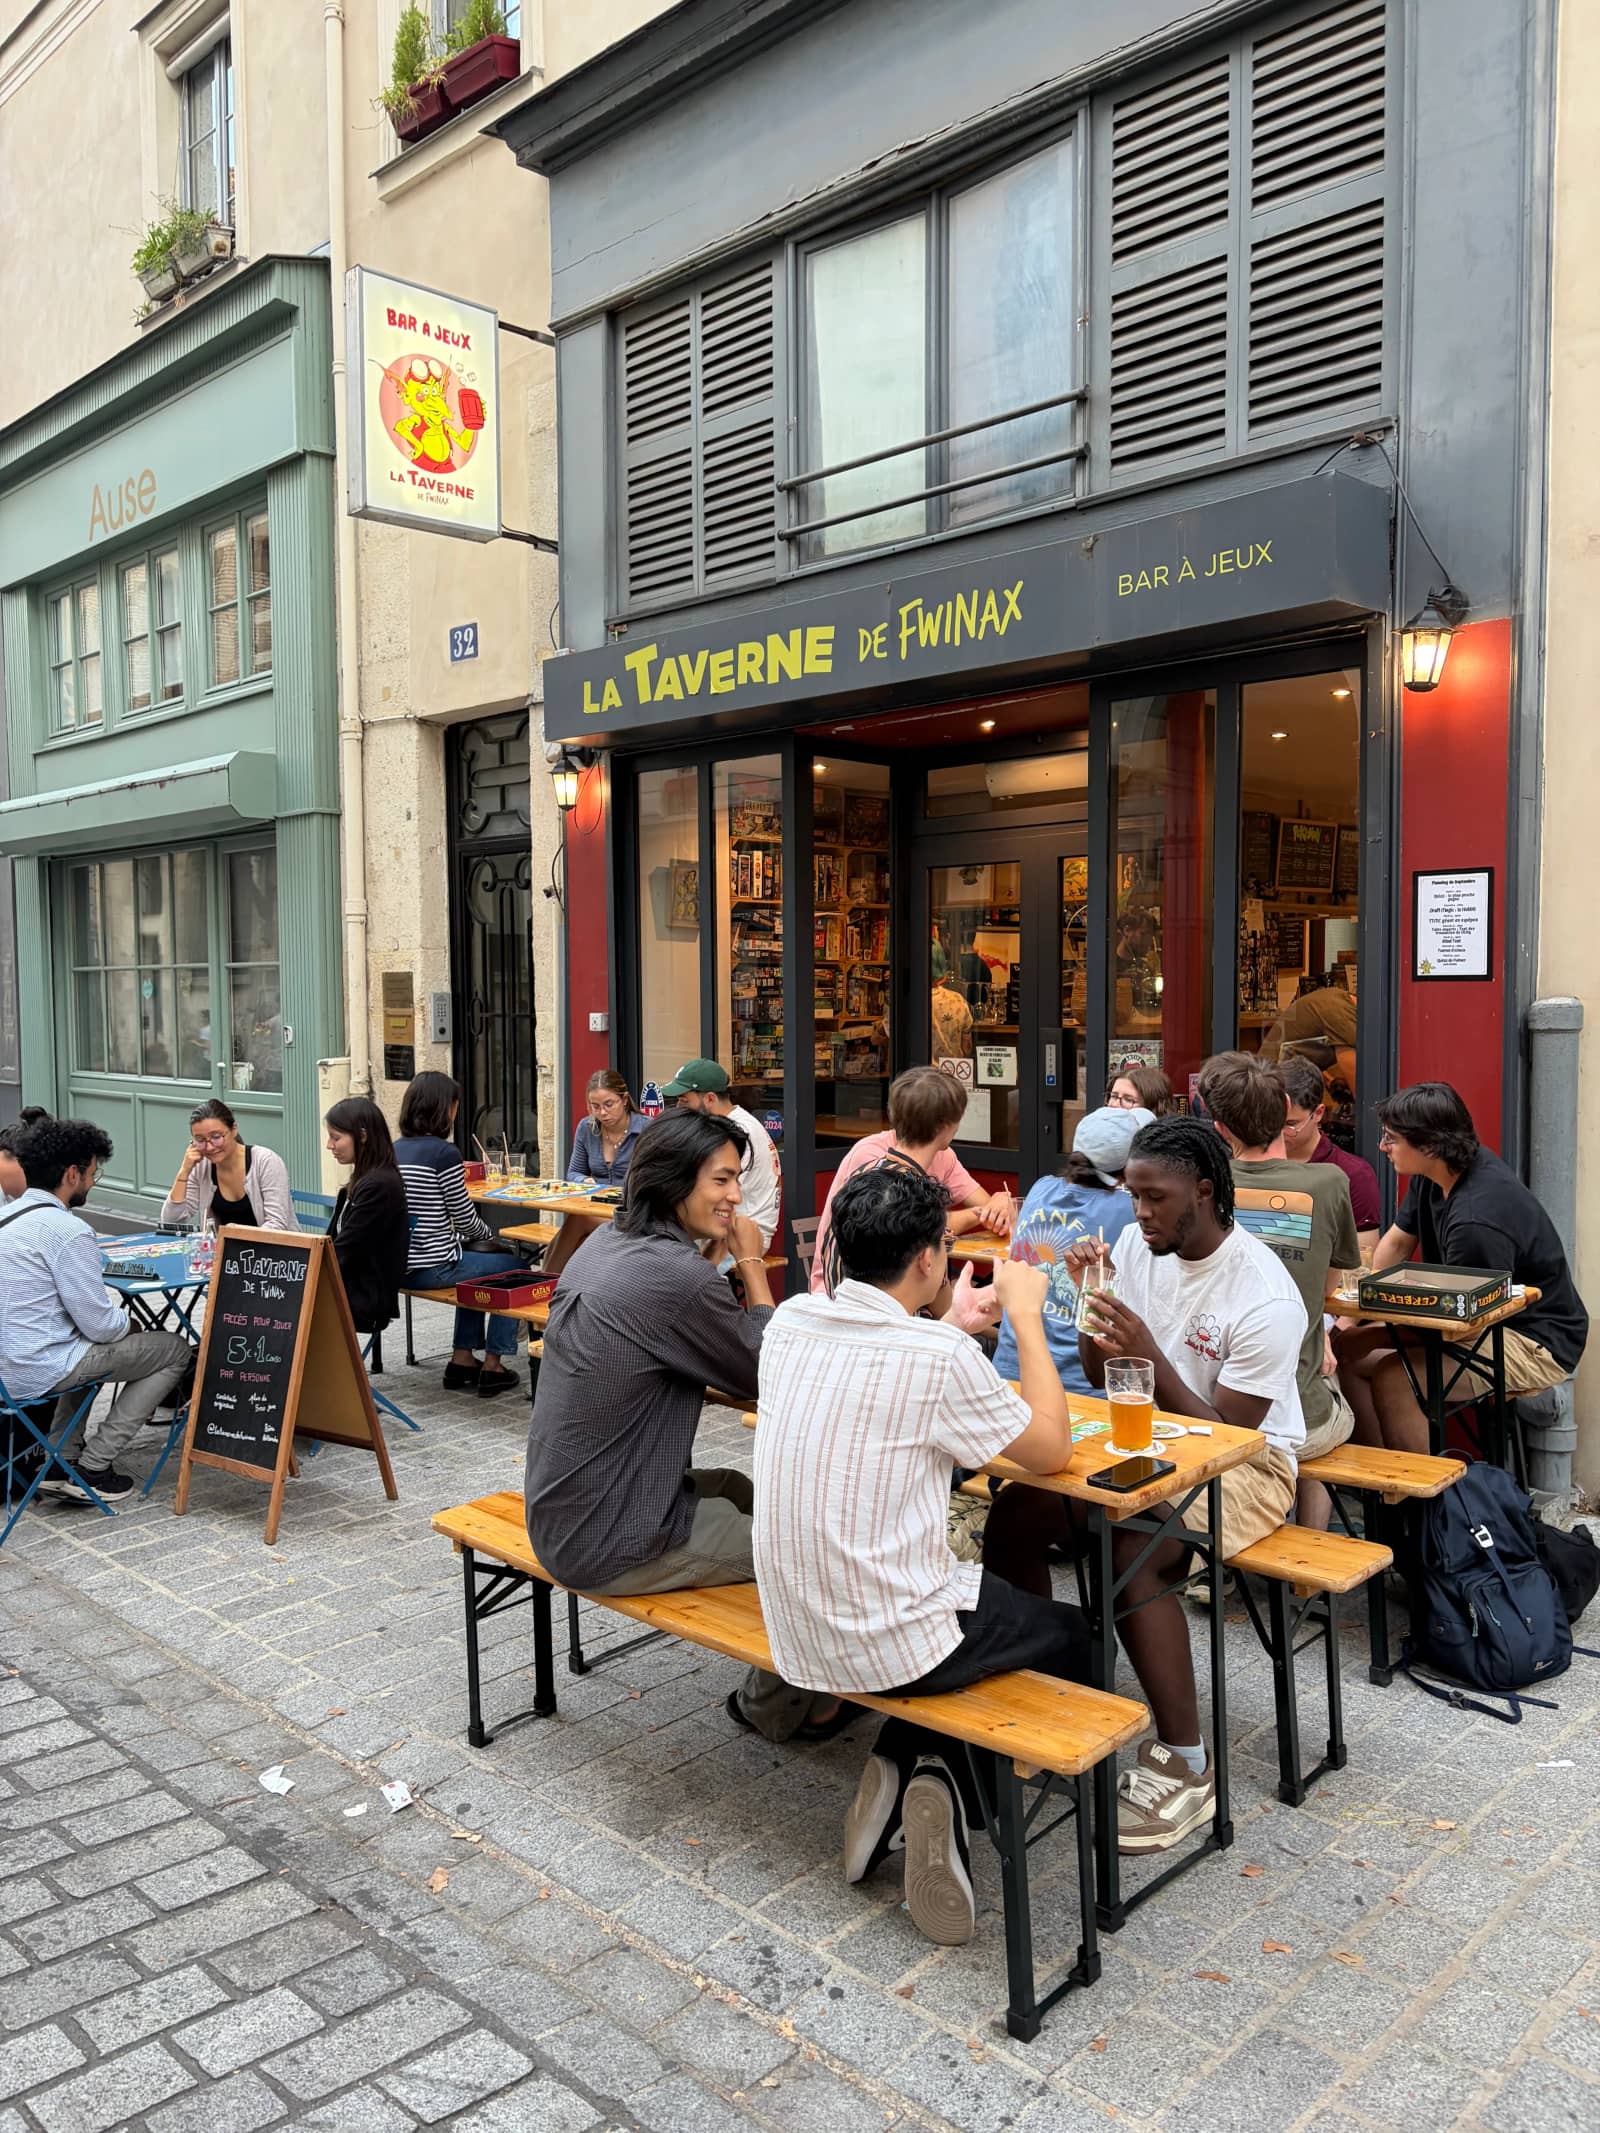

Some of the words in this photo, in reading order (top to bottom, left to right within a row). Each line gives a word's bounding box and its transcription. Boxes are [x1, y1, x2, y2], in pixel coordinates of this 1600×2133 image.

[387, 307, 416, 332] BAR
[434, 324, 472, 350] JEUX
[389, 471, 406, 484] LA
[407, 470, 475, 500] TAVERNE
[89, 468, 157, 542] Ause
[1118, 566, 1169, 597] BAR
[1177, 555, 1196, 583] À
[1204, 540, 1272, 577] JEUX
[454, 627, 474, 658] 32
[583, 679, 623, 714] LA
[624, 626, 835, 704] TAVERNE
[858, 622, 888, 663] DE
[899, 580, 1023, 660] FWINAX
[764, 1120, 782, 1130] 2024
[225, 1259, 239, 1274] LA
[240, 1249, 307, 1281] TAVERNE
[242, 1280, 255, 1294] DE
[475, 1290, 491, 1301] CATAN
[532, 1285, 551, 1298] CATAN
[253, 1316, 271, 1326] POUR
[220, 1368, 234, 1379] PAR
[1150, 1743, 1171, 1764] VANS
